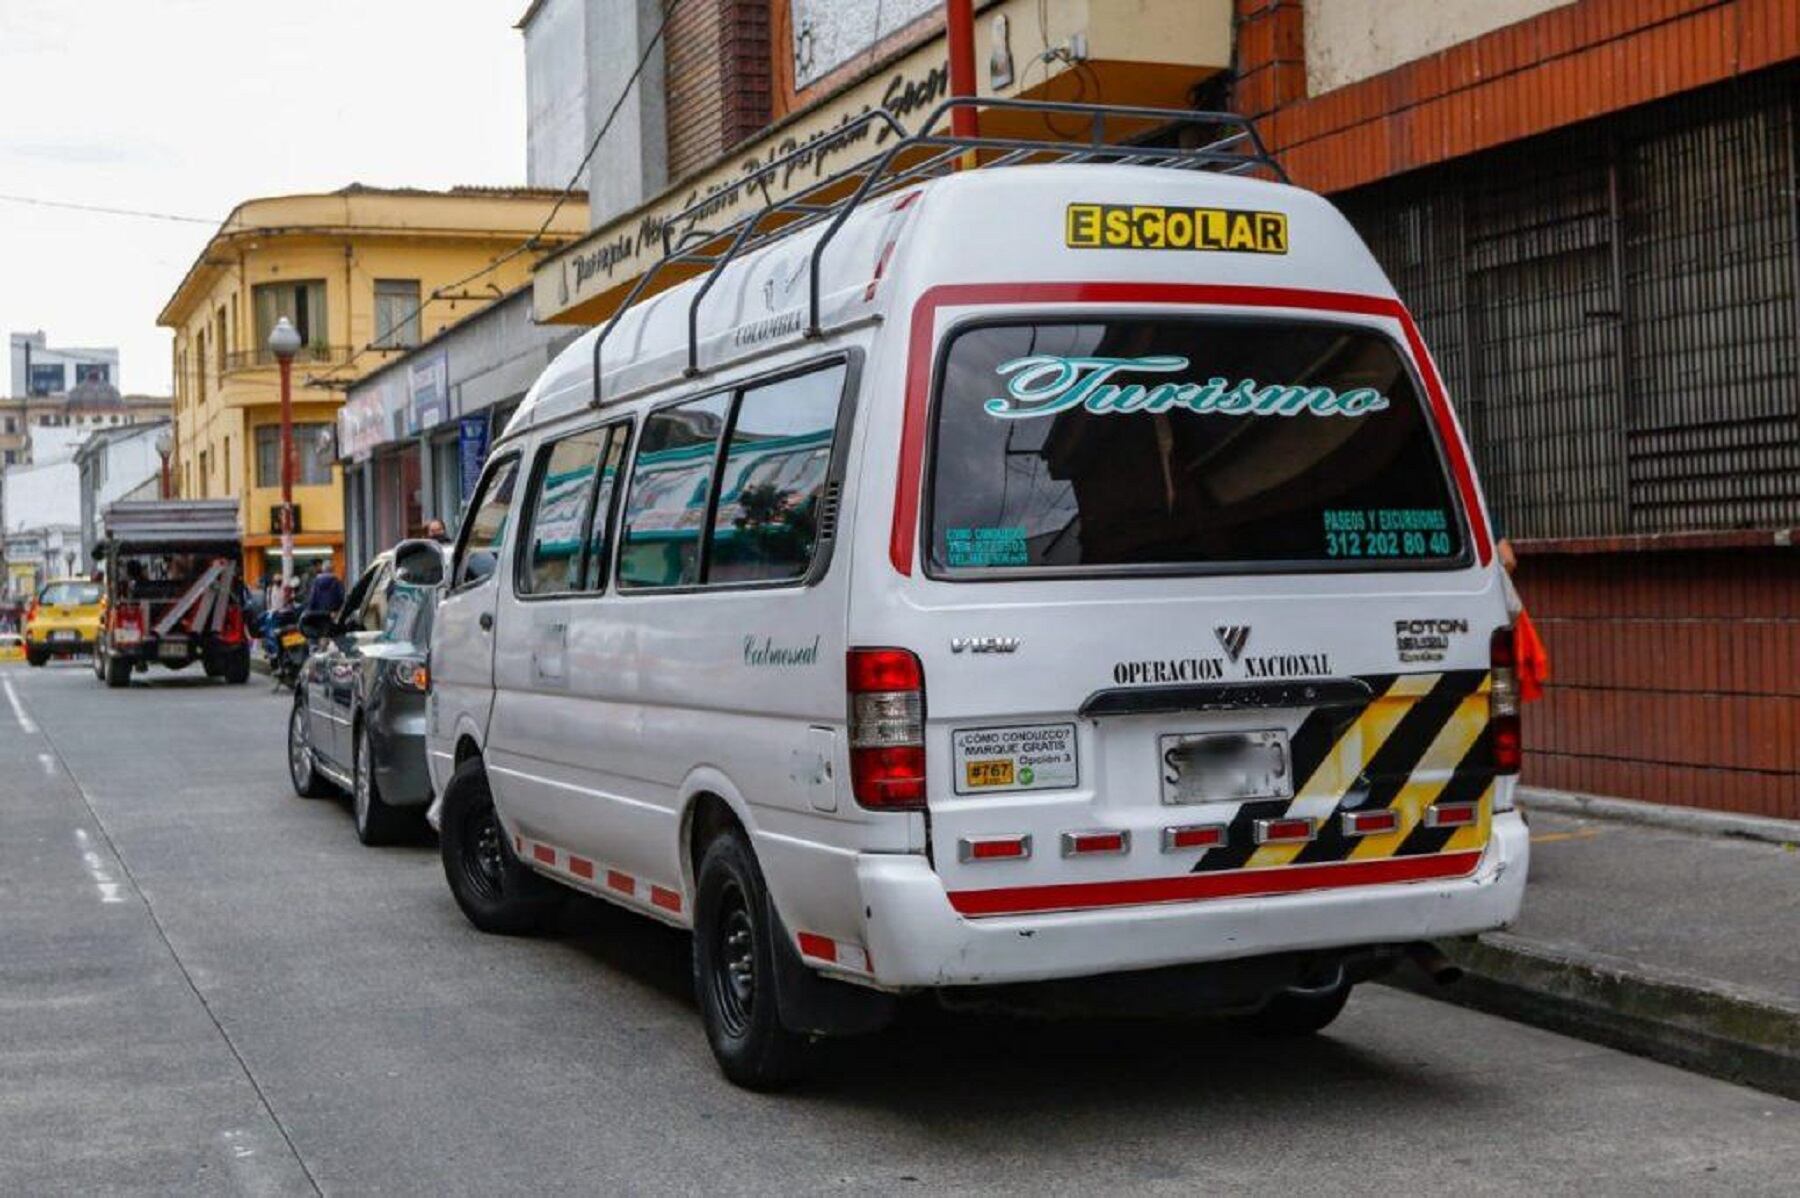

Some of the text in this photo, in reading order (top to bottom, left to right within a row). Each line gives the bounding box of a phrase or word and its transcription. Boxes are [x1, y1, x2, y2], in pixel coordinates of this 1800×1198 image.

[1071, 207, 1284, 251] ESCOLAR
[985, 356, 1390, 418] Turismo
[1326, 532, 1450, 556] 312 202 80 40
[1395, 619, 1468, 634] FOTON
[951, 637, 1021, 654] VIEW
[1113, 653, 1333, 685] OPERACION NACIONAL
[965, 740, 1066, 757] MARQUE GRATIS
[971, 762, 1009, 778] #767
